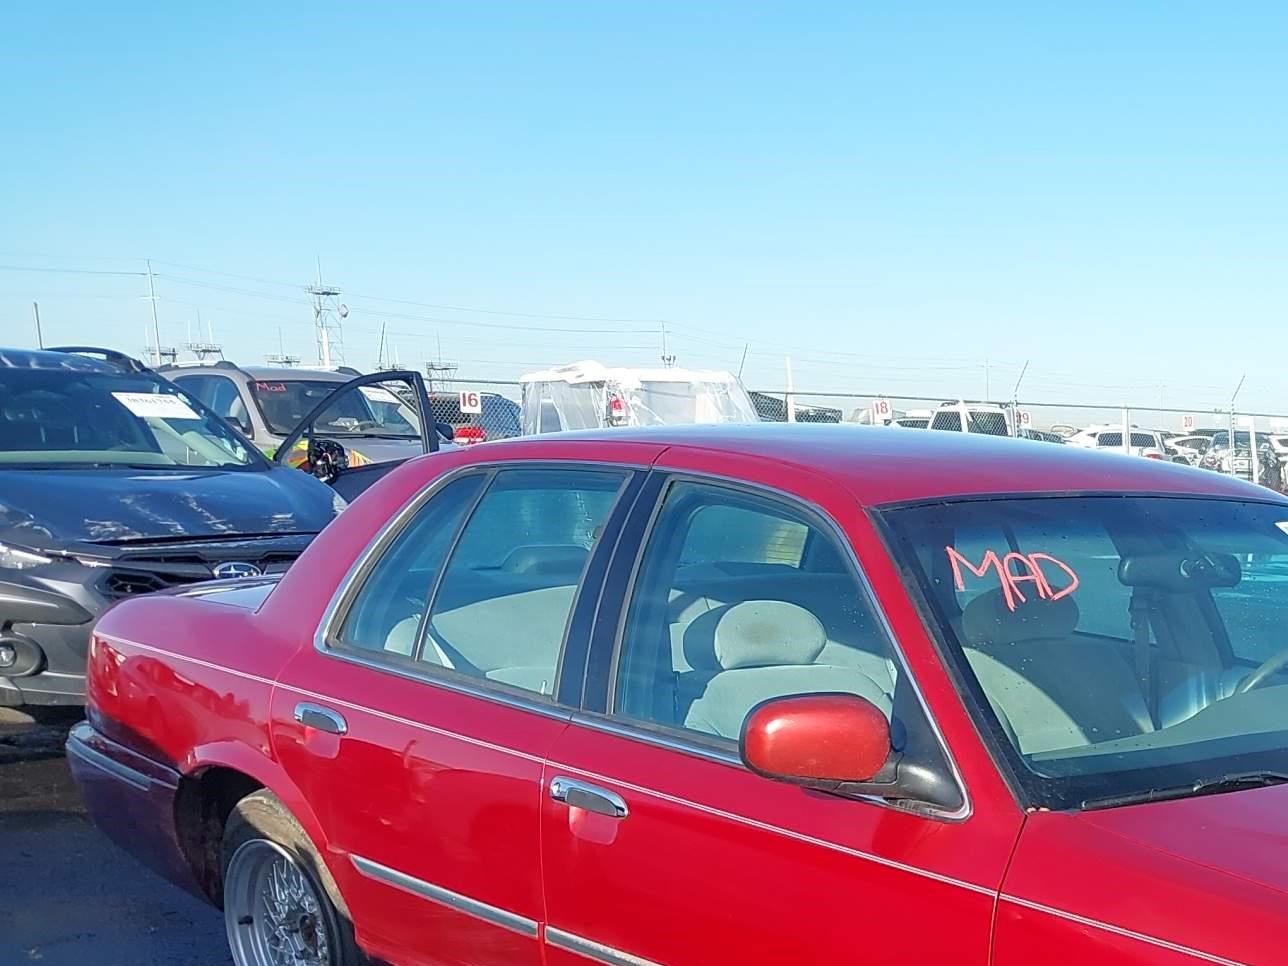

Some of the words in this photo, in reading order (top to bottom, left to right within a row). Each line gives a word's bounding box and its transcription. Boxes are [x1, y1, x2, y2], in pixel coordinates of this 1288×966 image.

[462, 393, 478, 407] 16
[875, 401, 888, 414] 18
[945, 546, 1079, 612] MAD
